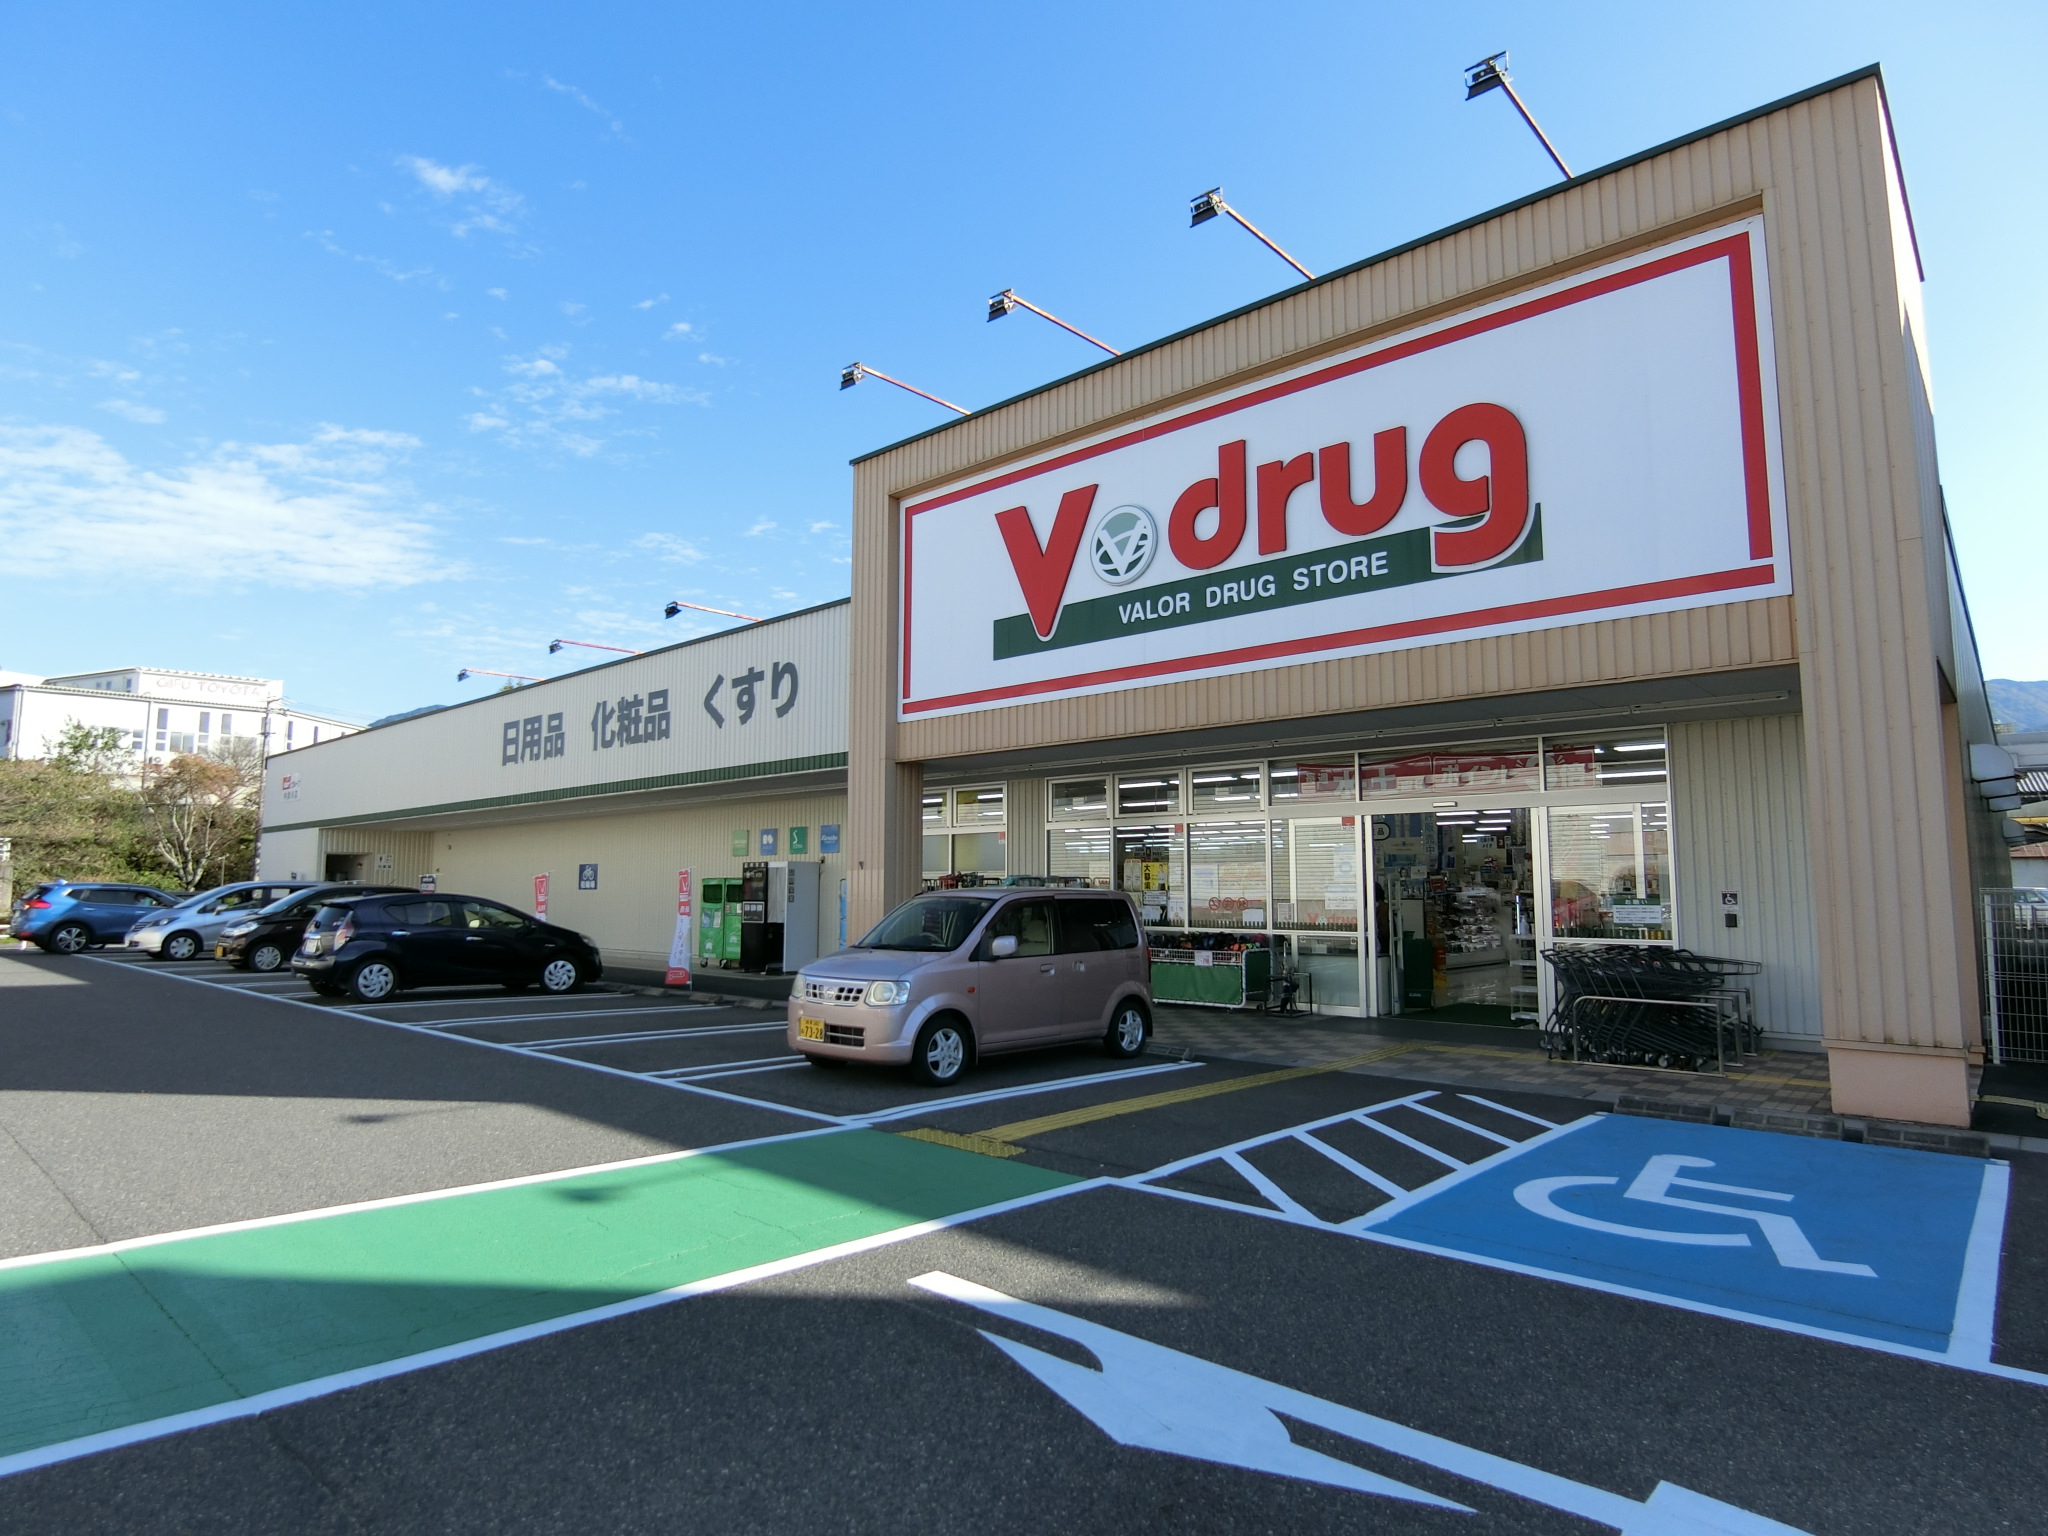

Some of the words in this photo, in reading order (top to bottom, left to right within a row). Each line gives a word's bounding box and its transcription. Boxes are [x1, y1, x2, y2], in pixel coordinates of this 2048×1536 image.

[994, 483, 1099, 638] V
[1168, 402, 1529, 569] drug
[1118, 592, 1191, 624] VALOR
[1205, 573, 1276, 608] DRUG
[1292, 551, 1389, 591] STORE
[157, 677, 191, 690] GIFU
[198, 681, 260, 696] TOYOTA
[502, 712, 565, 766] 日用品
[591, 689, 671, 751] 化粧品
[704, 661, 799, 729] くすり
